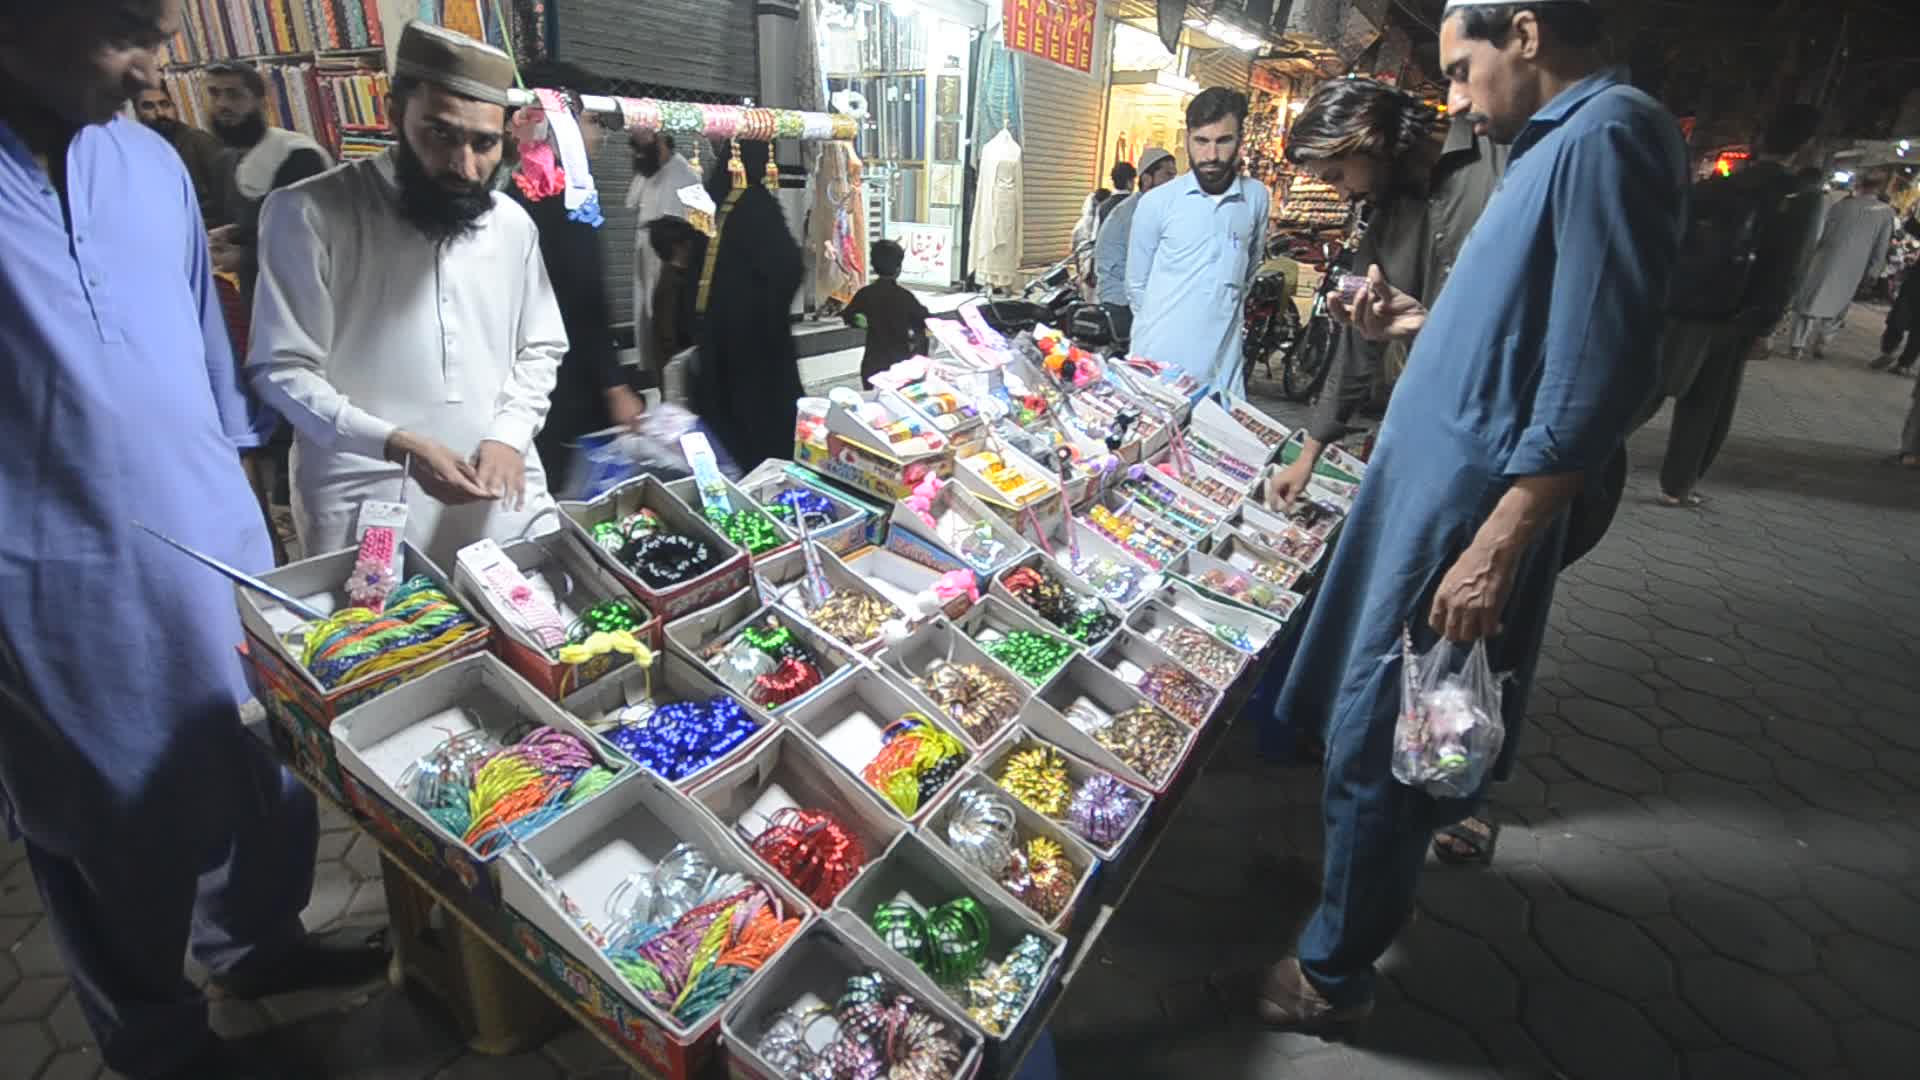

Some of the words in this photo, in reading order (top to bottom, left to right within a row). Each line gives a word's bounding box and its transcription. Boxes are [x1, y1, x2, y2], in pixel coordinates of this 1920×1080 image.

[1016, 0, 1029, 48] ALE
[1033, 0, 1047, 53] ALE
[1050, 5, 1064, 59] ALE
[1080, 2, 1094, 68] SALE
